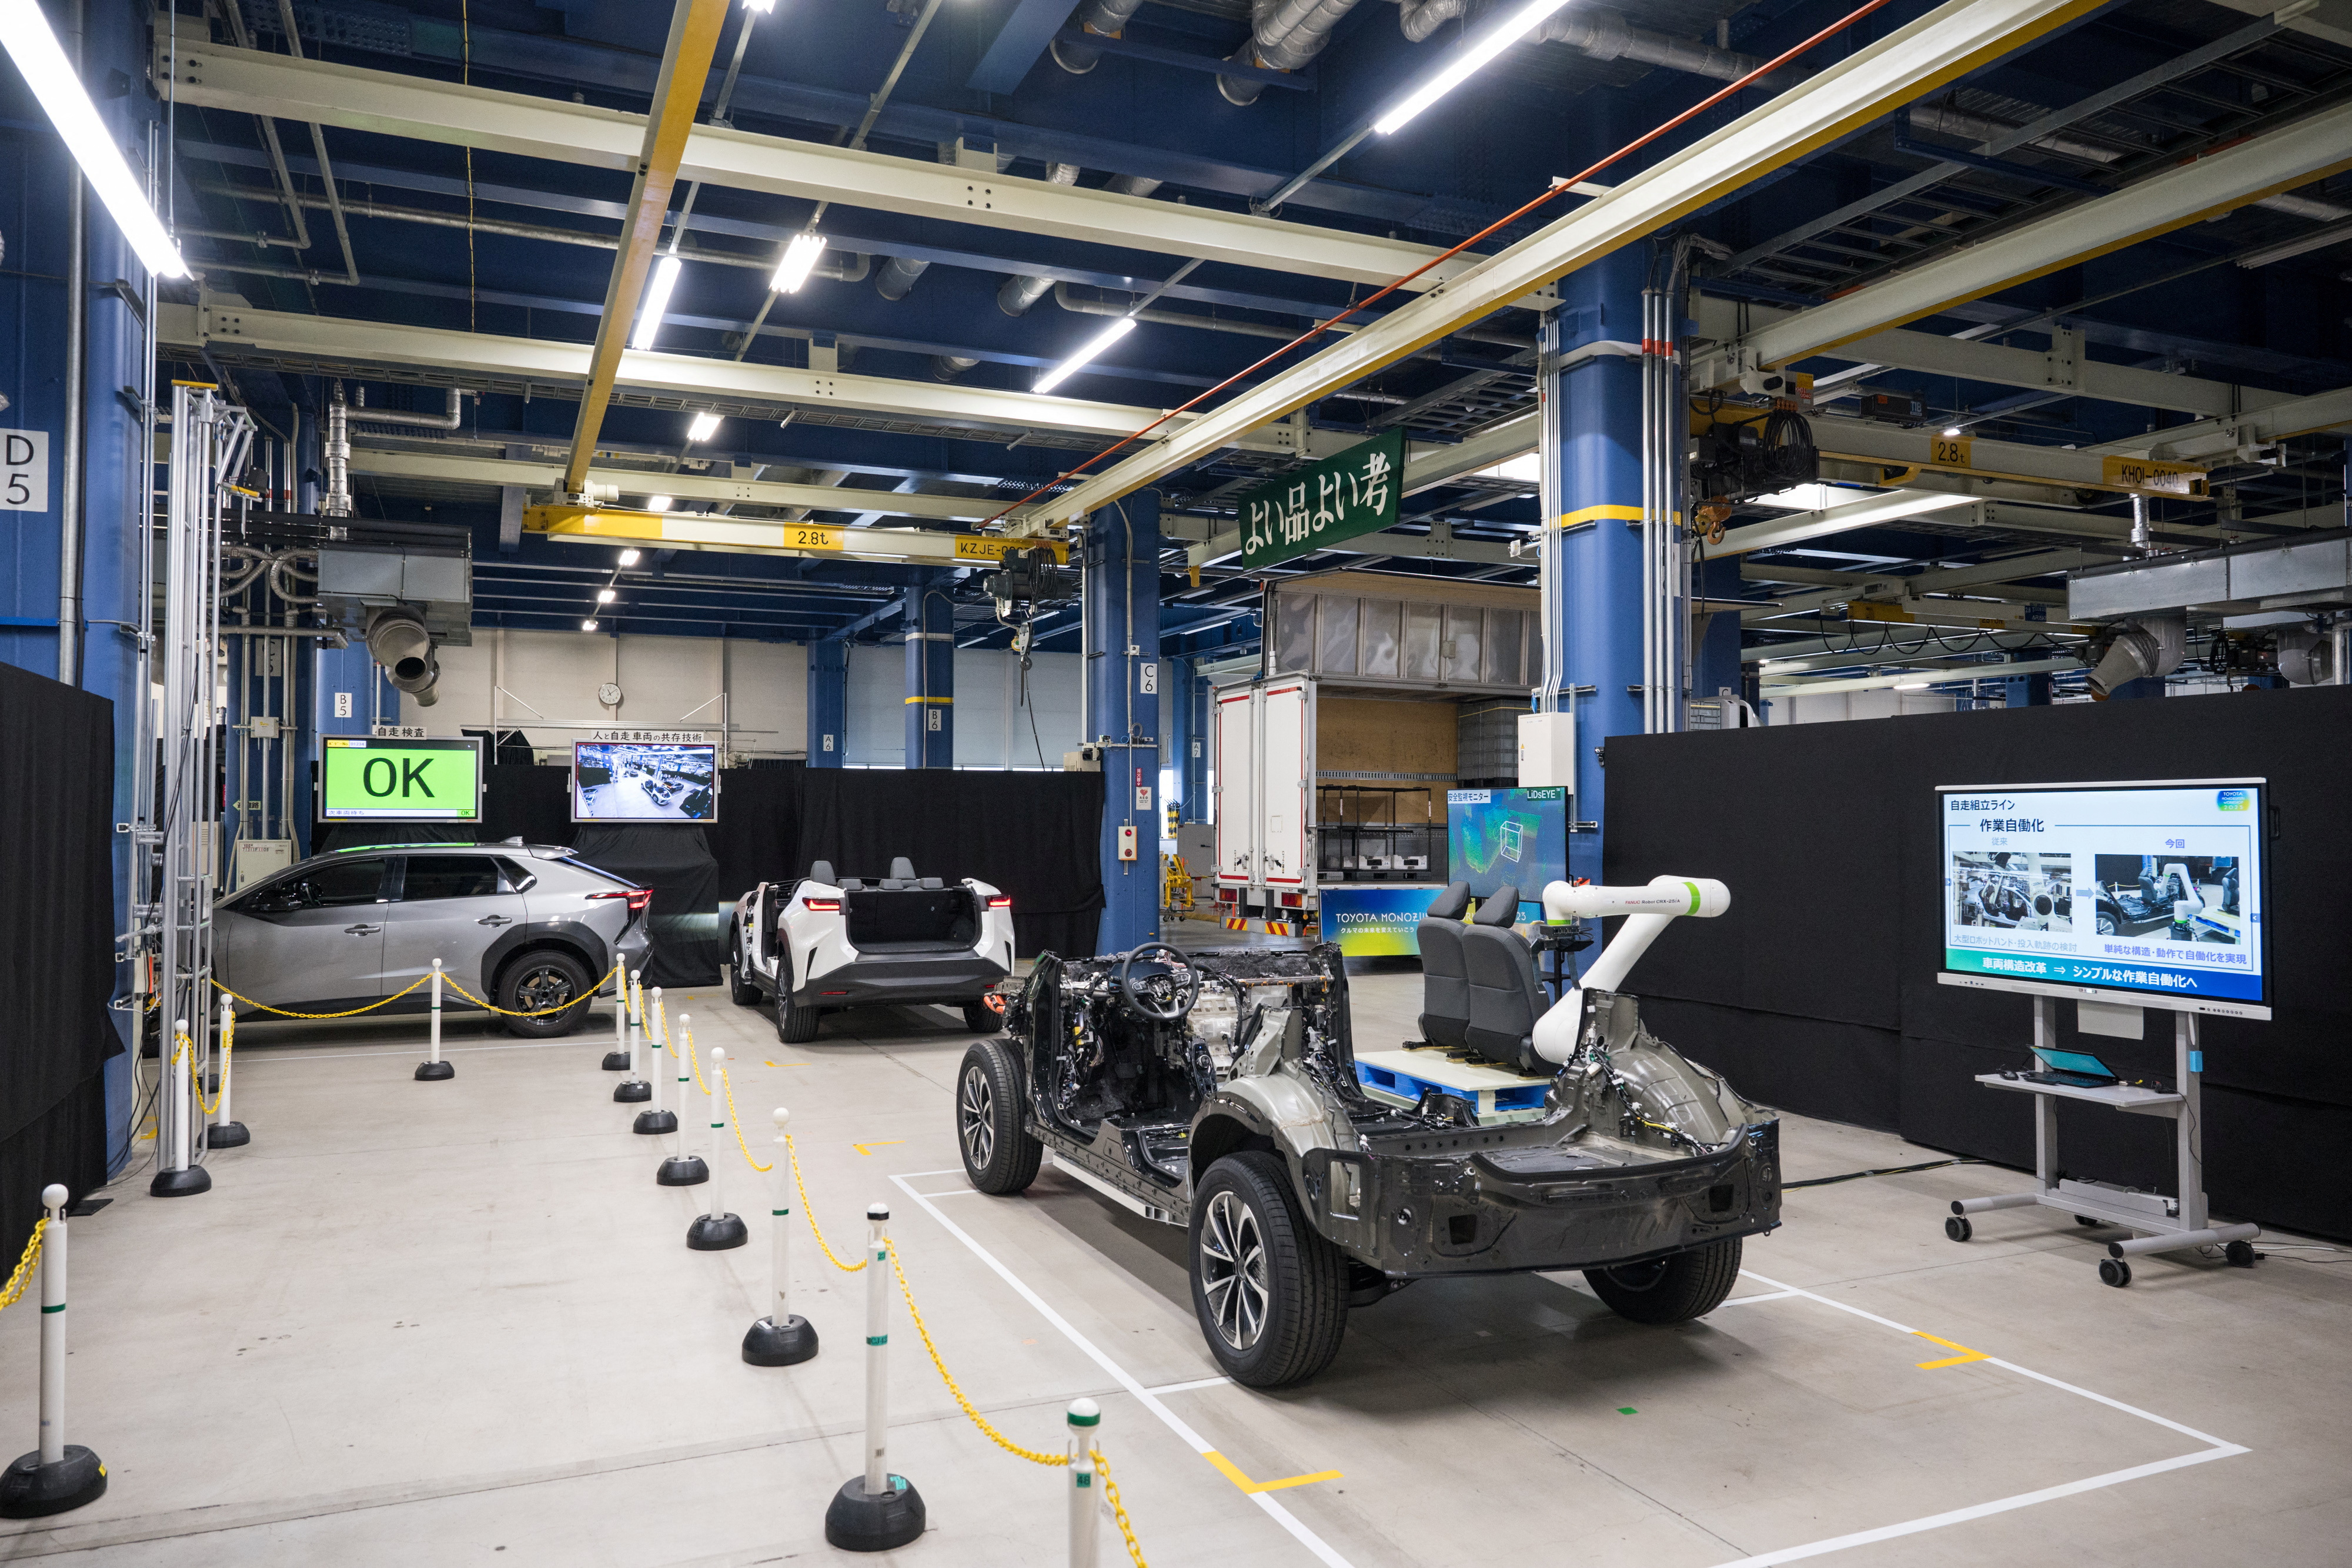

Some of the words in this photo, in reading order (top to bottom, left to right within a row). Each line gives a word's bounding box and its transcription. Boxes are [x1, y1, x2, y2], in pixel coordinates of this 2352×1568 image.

[1911, 401, 1922, 412] TIB
[6, 434, 34, 466] D
[1938, 442, 1965, 463] 2.8t
[6, 473, 30, 505] 5
[1245, 452, 1391, 555] よい品よい考
[798, 531, 829, 546] 2.8t
[960, 542, 1030, 556] KZJE-0
[1145, 665, 1154, 677] C
[1145, 680, 1153, 691] 6
[340, 694, 347, 704] B
[339, 706, 347, 716] 5
[932, 711, 938, 719] B
[932, 721, 938, 730] 6
[377, 726, 425, 738] 自走検査
[593, 731, 702, 743] 人と自走車両の共存技術
[363, 757, 435, 798] OK
[1448, 792, 1489, 802] 安全監視モニター
[1527, 790, 1556, 799] LiDsEYE
[1950, 799, 2016, 811] 自走組立ライン
[1979, 818, 2044, 833] 作業自働化
[1992, 837, 2008, 846] 従来
[2165, 838, 2185, 848] 今回
[1336, 913, 1378, 922] TOYOTA
[1077, 1475, 1091, 1485] 48
